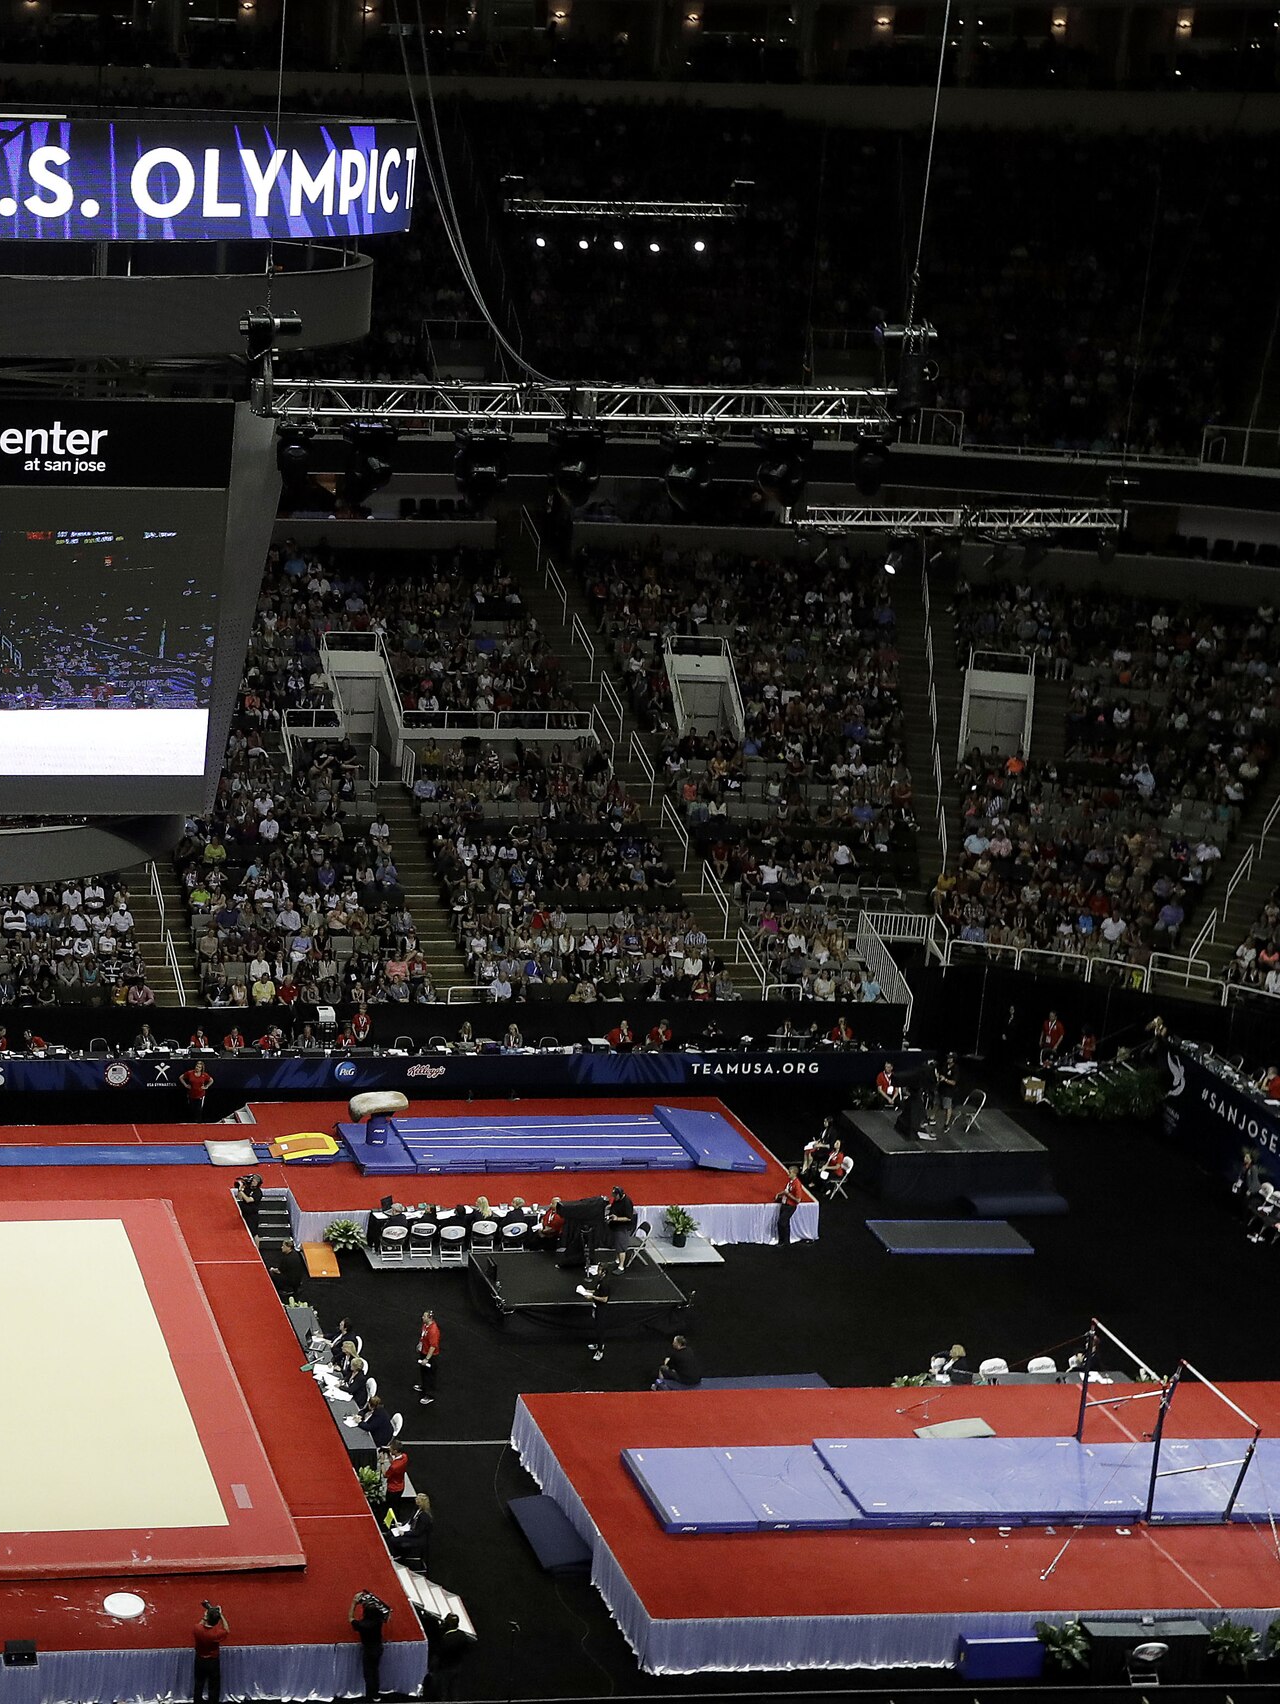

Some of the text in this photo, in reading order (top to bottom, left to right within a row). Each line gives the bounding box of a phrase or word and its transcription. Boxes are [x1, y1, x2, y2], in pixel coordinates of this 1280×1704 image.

[131, 148, 400, 218] OLYMPIC
[24, 458, 106, 474] at san jose
[339, 1068, 356, 1076] P&G
[407, 1064, 446, 1078] Kellogg's
[691, 1062, 819, 1075] TEAMUSA.ORG
